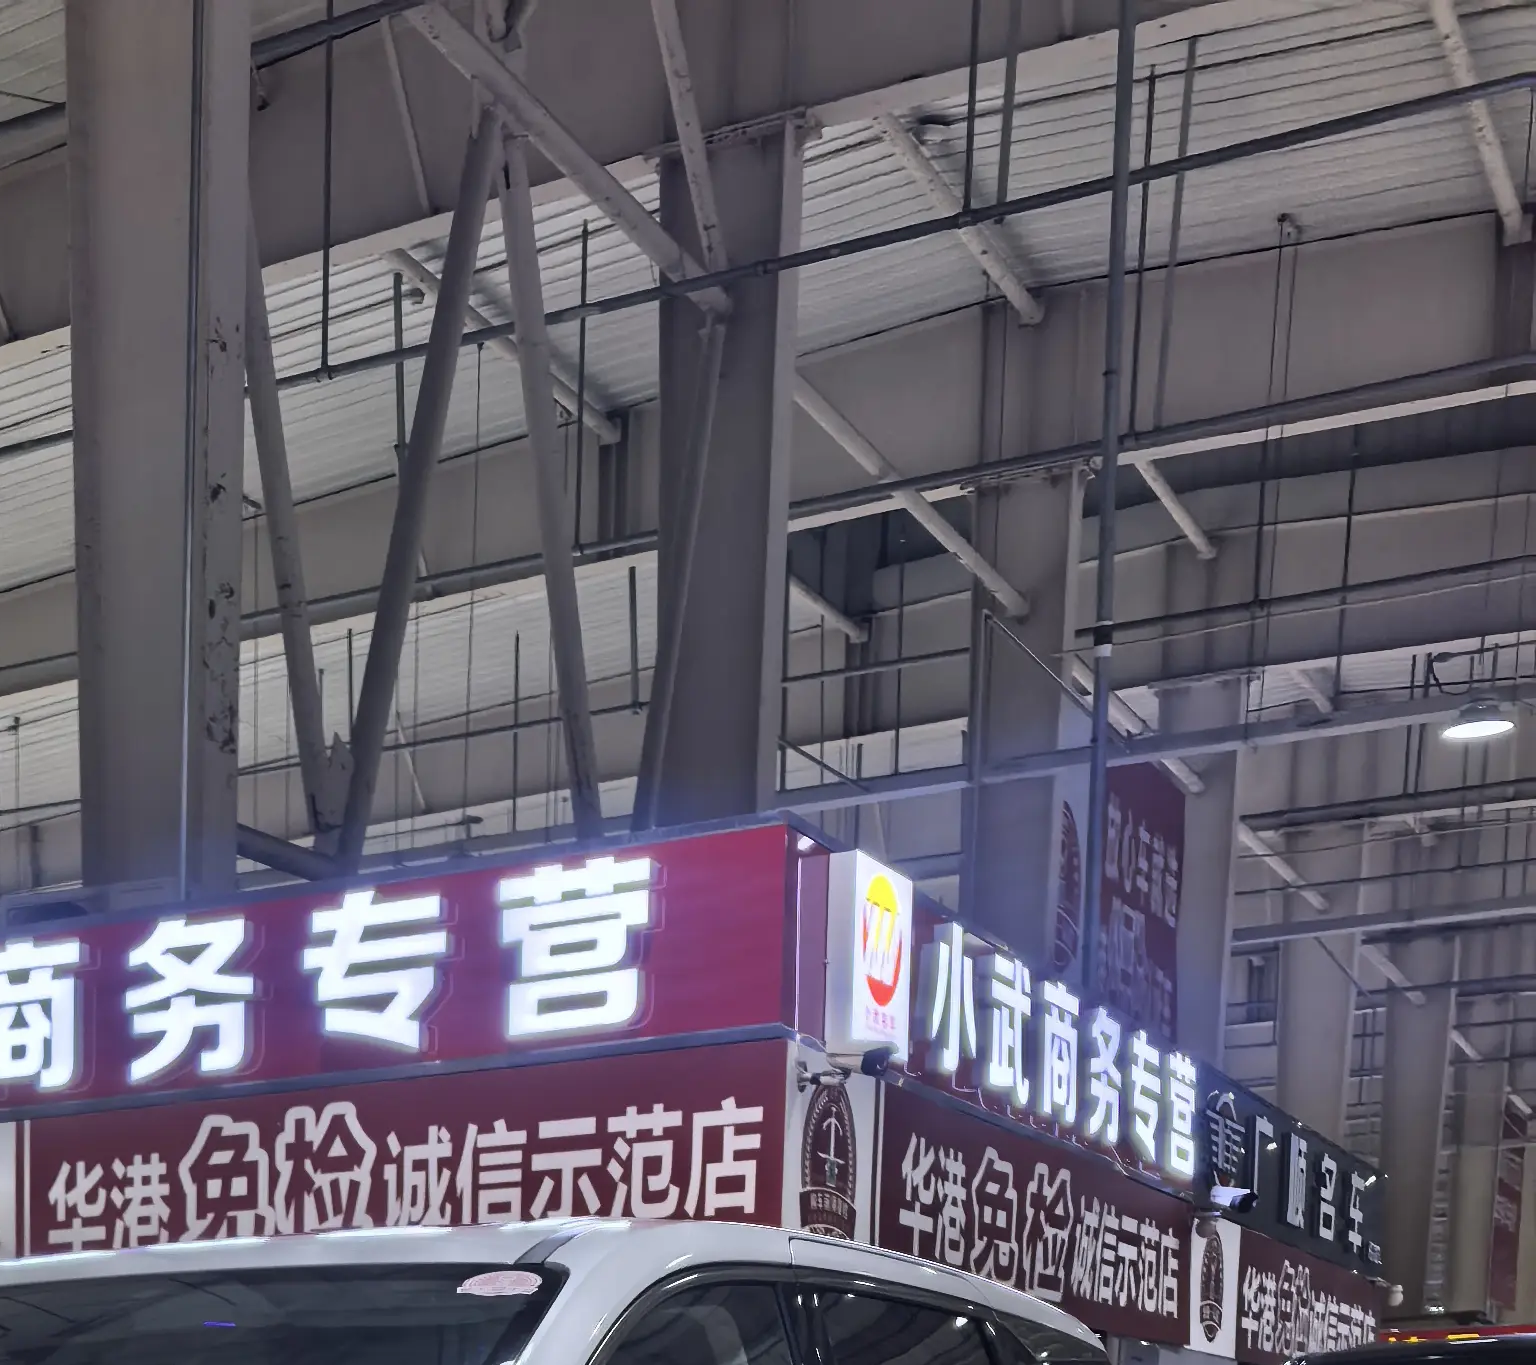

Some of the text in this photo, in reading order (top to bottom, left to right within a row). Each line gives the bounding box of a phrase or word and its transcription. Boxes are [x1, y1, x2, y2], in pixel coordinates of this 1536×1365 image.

[929, 921, 1199, 1177] 小武商务专营
[47, 1097, 764, 1252] 华港免检诚信示范店
[900, 1132, 1181, 1320] 华港免检诚信示范店
